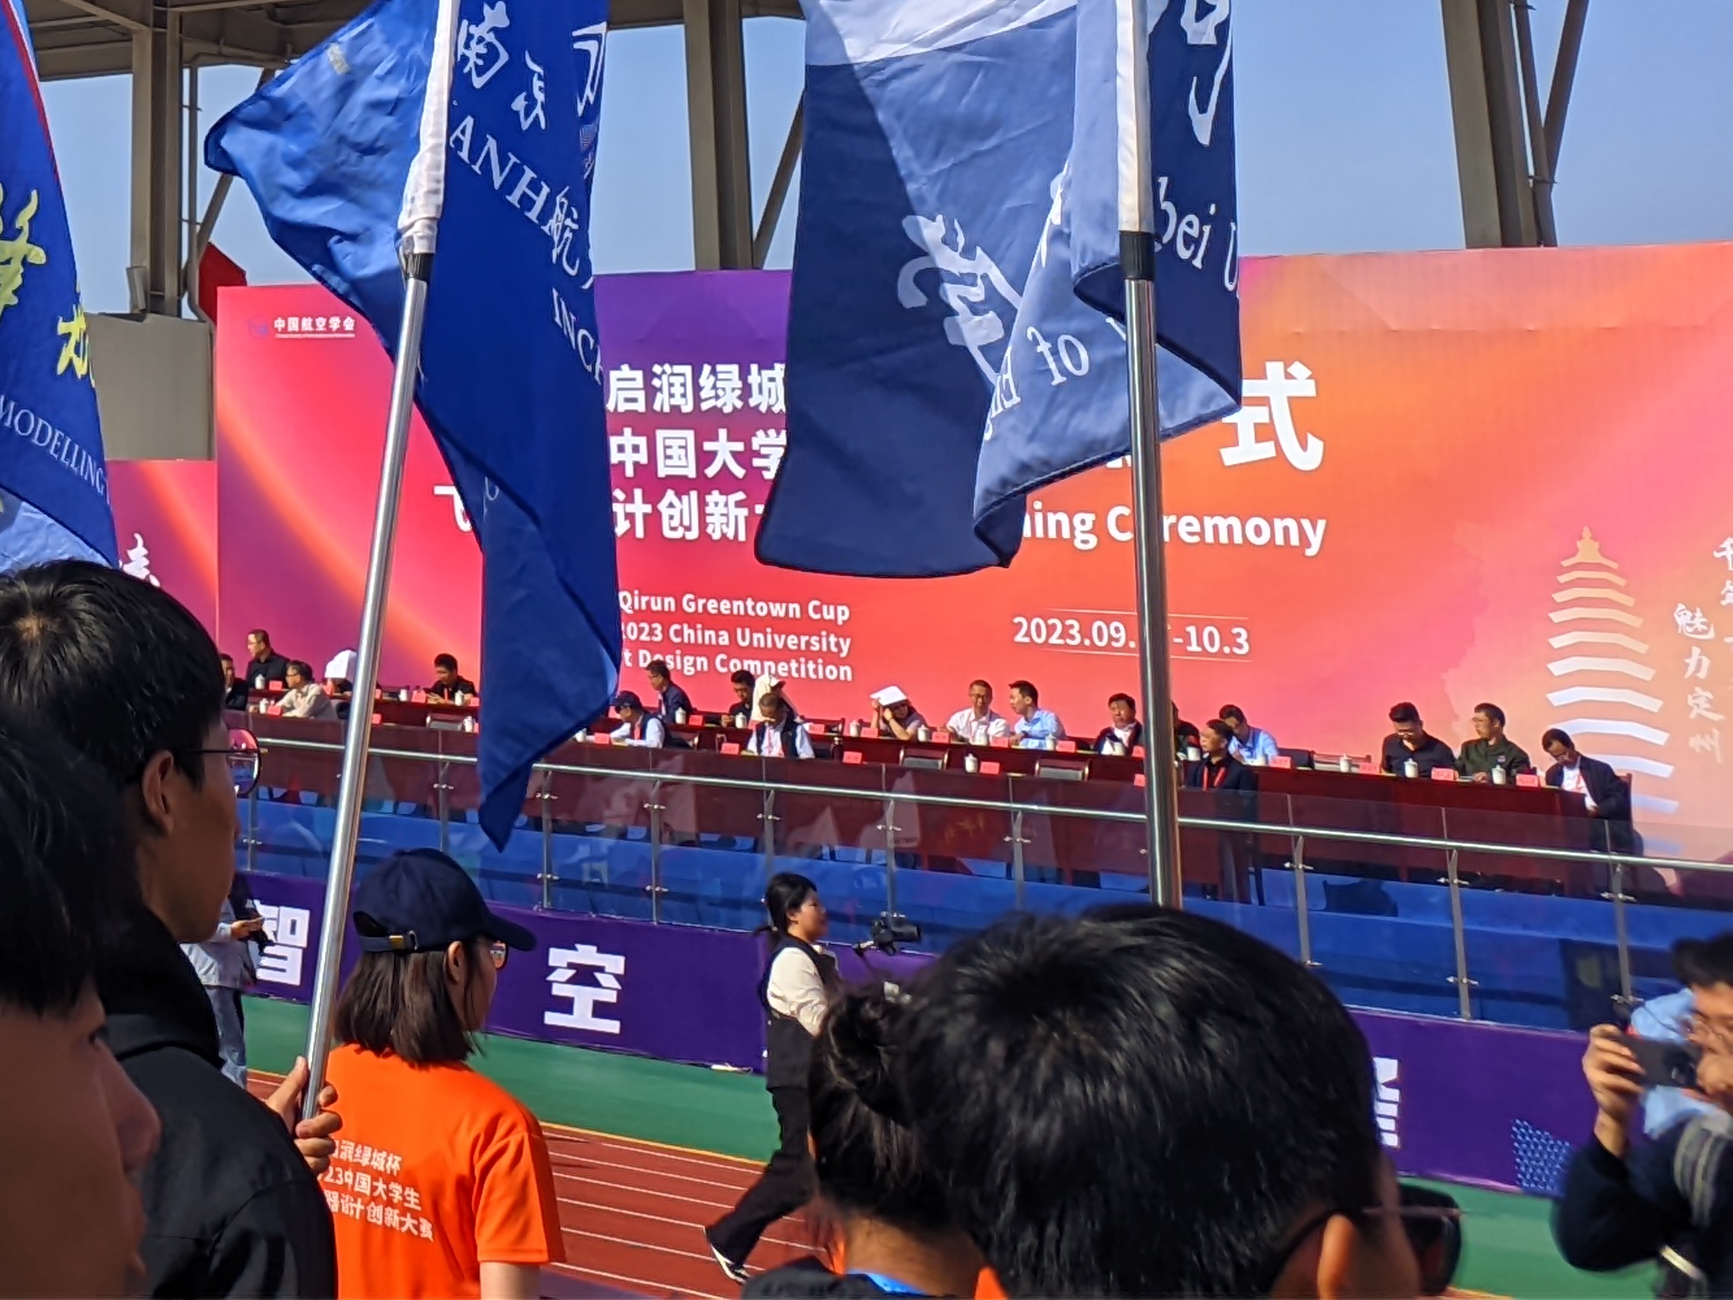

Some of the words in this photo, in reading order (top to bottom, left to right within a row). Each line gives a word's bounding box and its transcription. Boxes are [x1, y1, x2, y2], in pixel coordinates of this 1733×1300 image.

[274, 316, 355, 333] 中国航空学会
[612, 488, 765, 542] 计创新
[1106, 505, 1327, 557] Cremony
[618, 590, 675, 614] Qirun
[682, 594, 800, 618] Greentown
[807, 599, 850, 625] Cup
[669, 623, 730, 646] China
[736, 627, 851, 657] University
[715, 654, 852, 681] Competition
[543, 943, 626, 1035] 空
